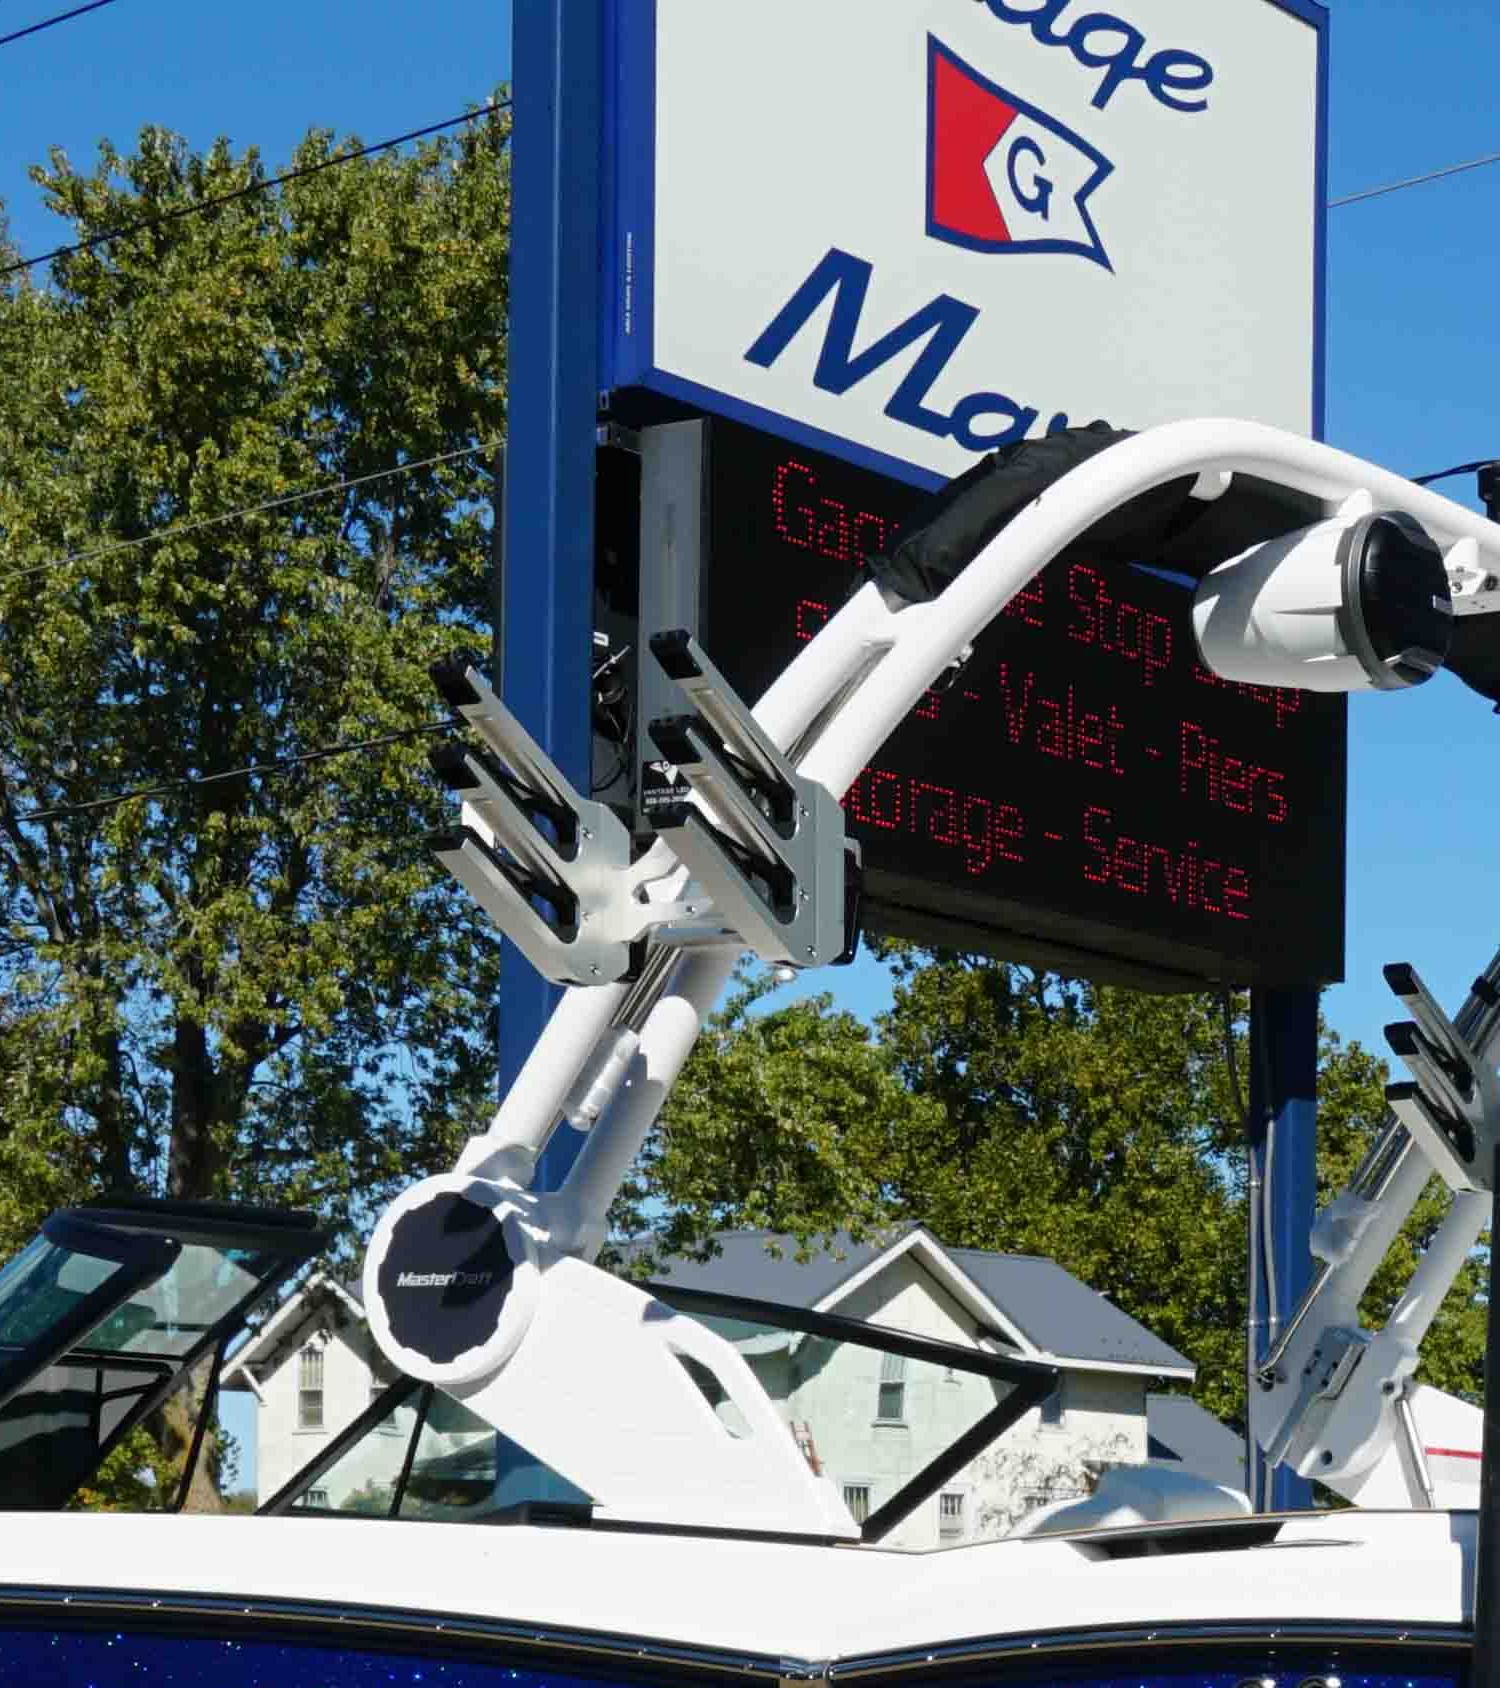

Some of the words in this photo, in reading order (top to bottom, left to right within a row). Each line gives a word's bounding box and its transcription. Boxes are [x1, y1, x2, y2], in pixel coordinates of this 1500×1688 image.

[974, 0, 1214, 112] age
[1006, 135, 1054, 222] G
[1068, 563, 1173, 687] Stop
[998, 662, 1125, 777] Valet
[1180, 720, 1289, 825] Piers
[840, 767, 1029, 876] torage
[1084, 804, 1253, 922] Service
